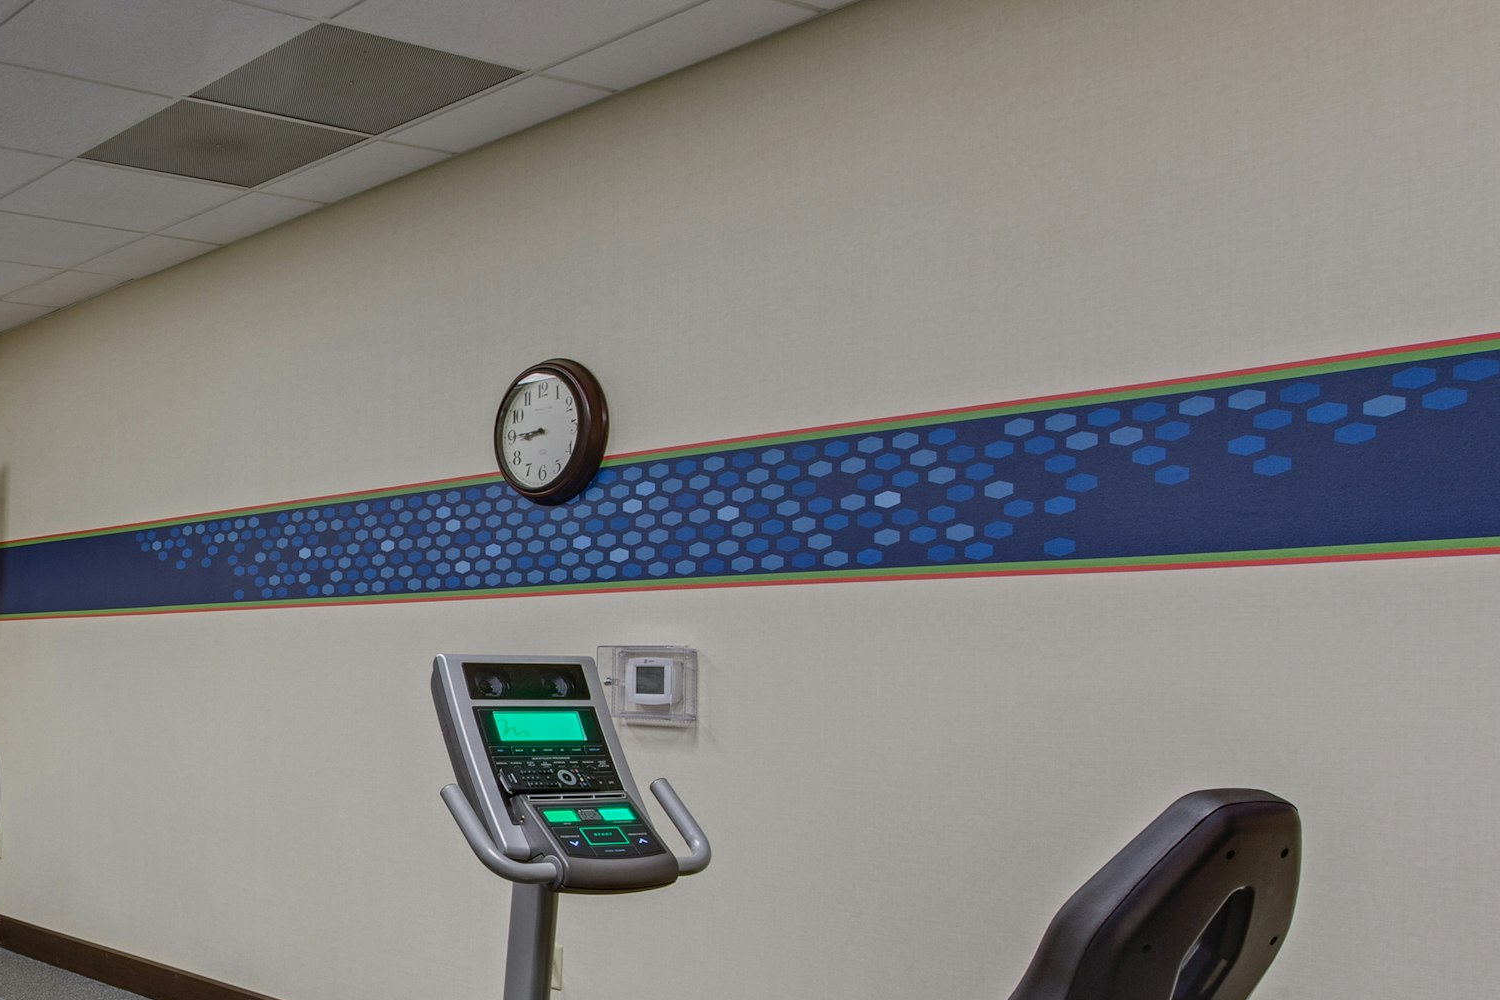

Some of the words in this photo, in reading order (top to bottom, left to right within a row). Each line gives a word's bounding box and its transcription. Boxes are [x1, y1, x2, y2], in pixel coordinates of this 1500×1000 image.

[538, 382, 548, 399] 12
[524, 391, 531, 406] 11
[565, 396, 573, 412] 2
[512, 408, 524, 424] 10
[507, 430, 517, 445] 9
[513, 450, 521, 465] 8
[525, 463, 532, 477] 7
[538, 465, 547, 481] 6
[553, 459, 561, 474] 5
